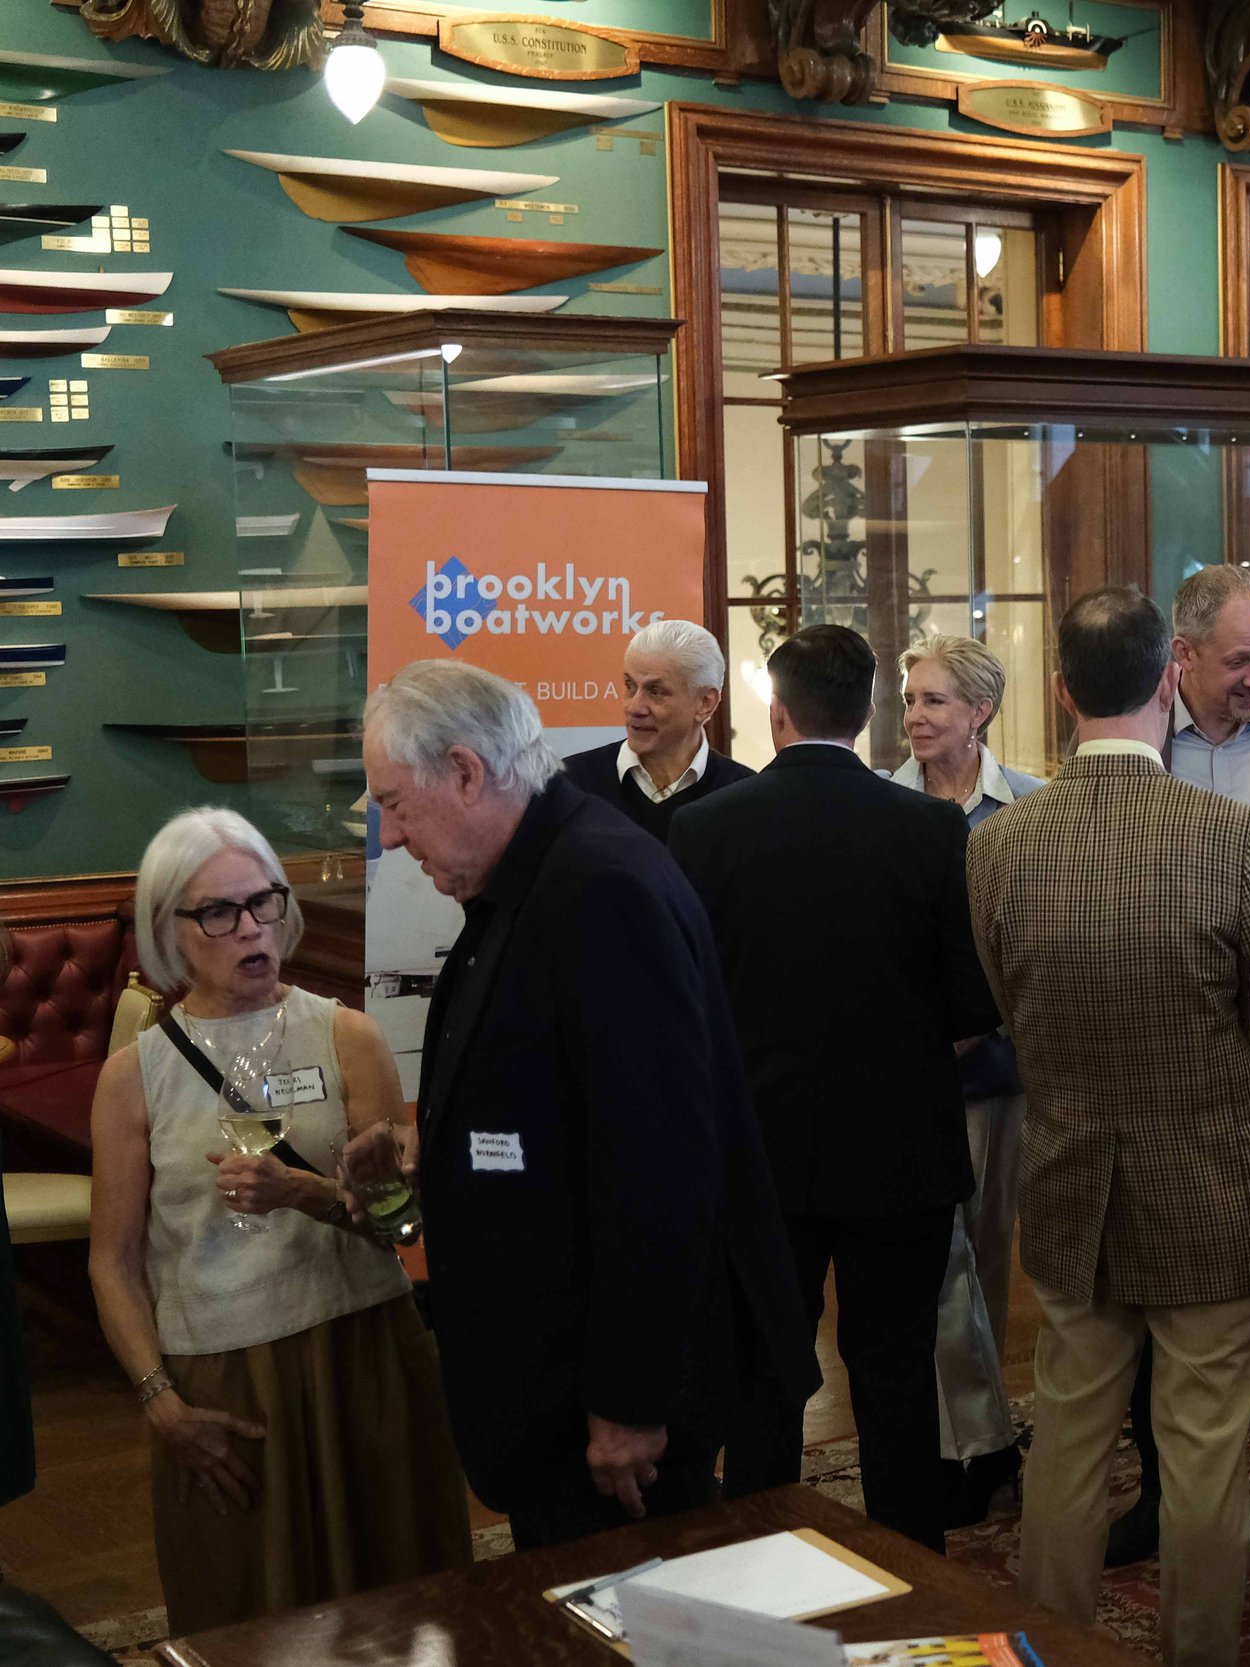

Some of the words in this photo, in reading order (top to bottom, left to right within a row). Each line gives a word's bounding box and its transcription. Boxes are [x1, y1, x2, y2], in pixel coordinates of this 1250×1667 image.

[493, 33, 518, 46] U.S.S.
[522, 36, 587, 54] CONSTITUTION
[426, 560, 630, 605] brooklyn
[537, 682, 599, 701] BUILD
[603, 682, 619, 701] A
